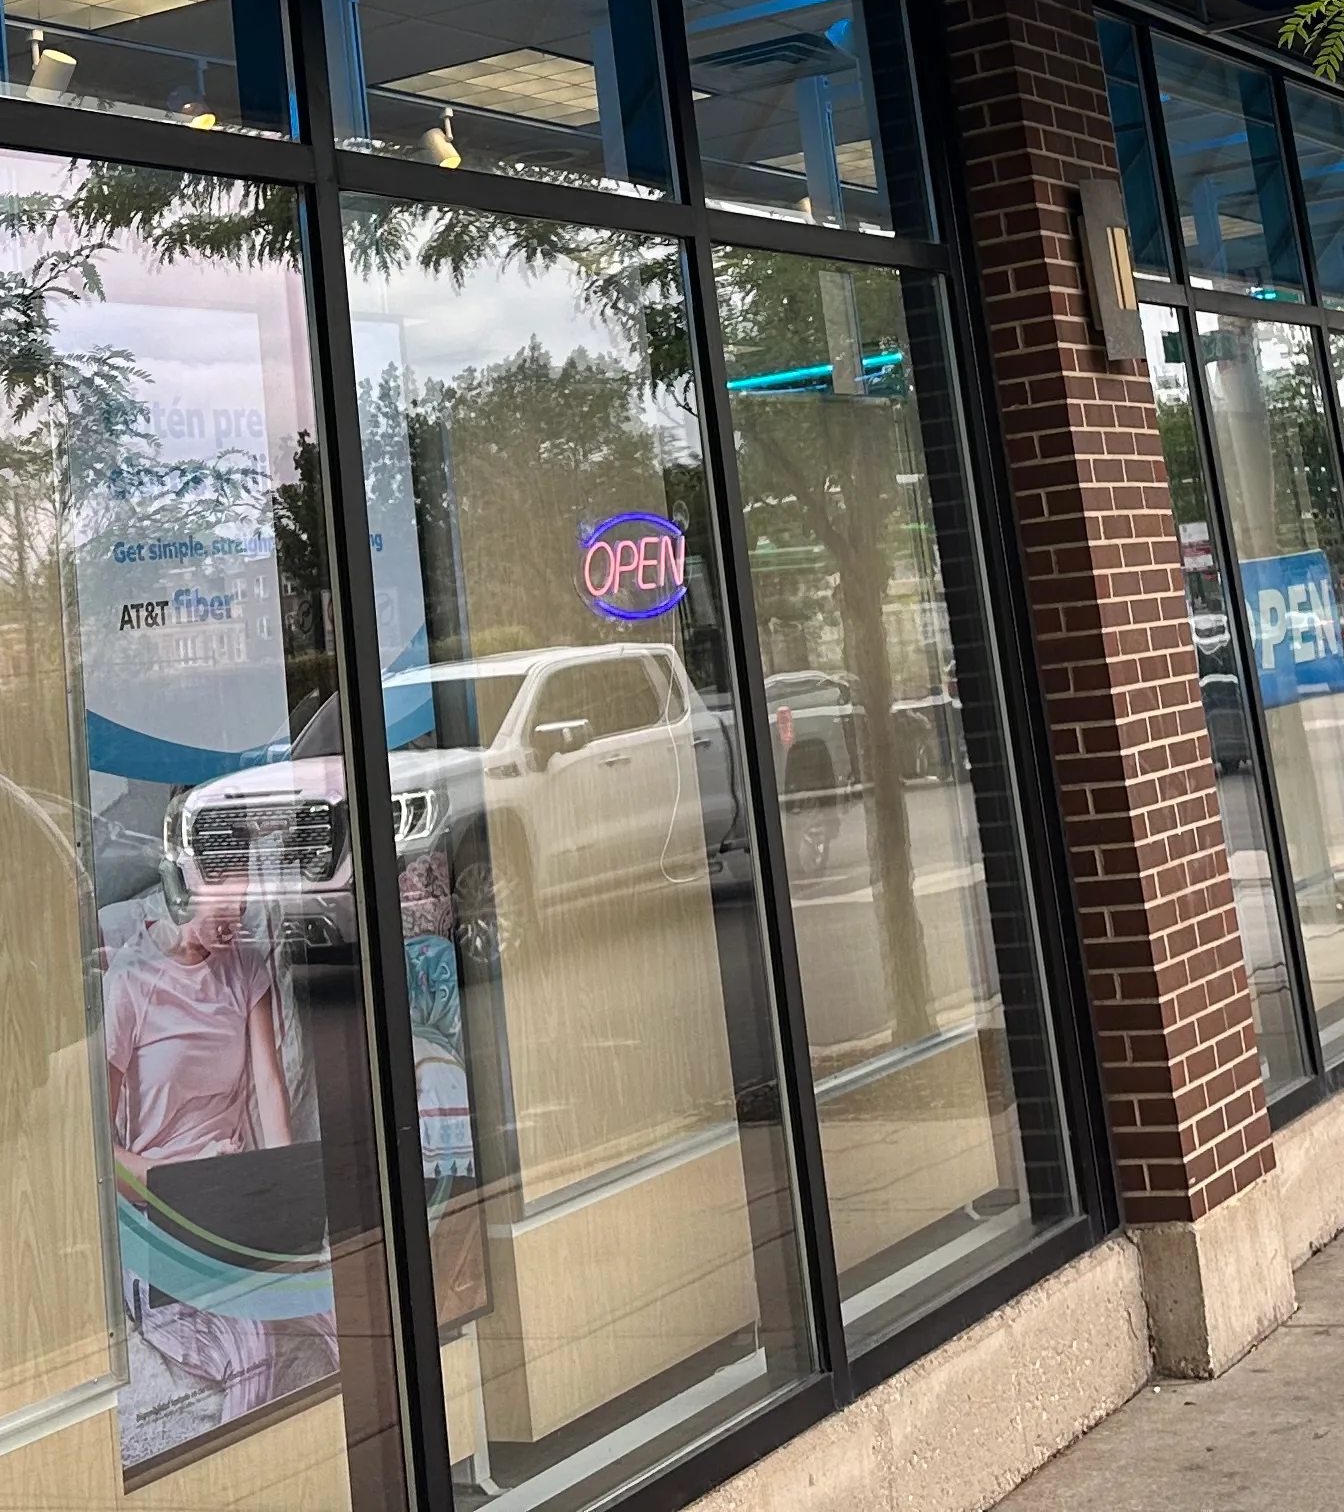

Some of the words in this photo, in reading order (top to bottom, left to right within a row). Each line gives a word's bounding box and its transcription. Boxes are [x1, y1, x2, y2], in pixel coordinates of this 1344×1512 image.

[113, 541, 145, 563] Get
[149, 535, 208, 564] simple,
[584, 535, 685, 596] OPEN
[119, 600, 169, 630] AT&T
[172, 588, 234, 625] fiber
[1245, 579, 1338, 669] PEN
